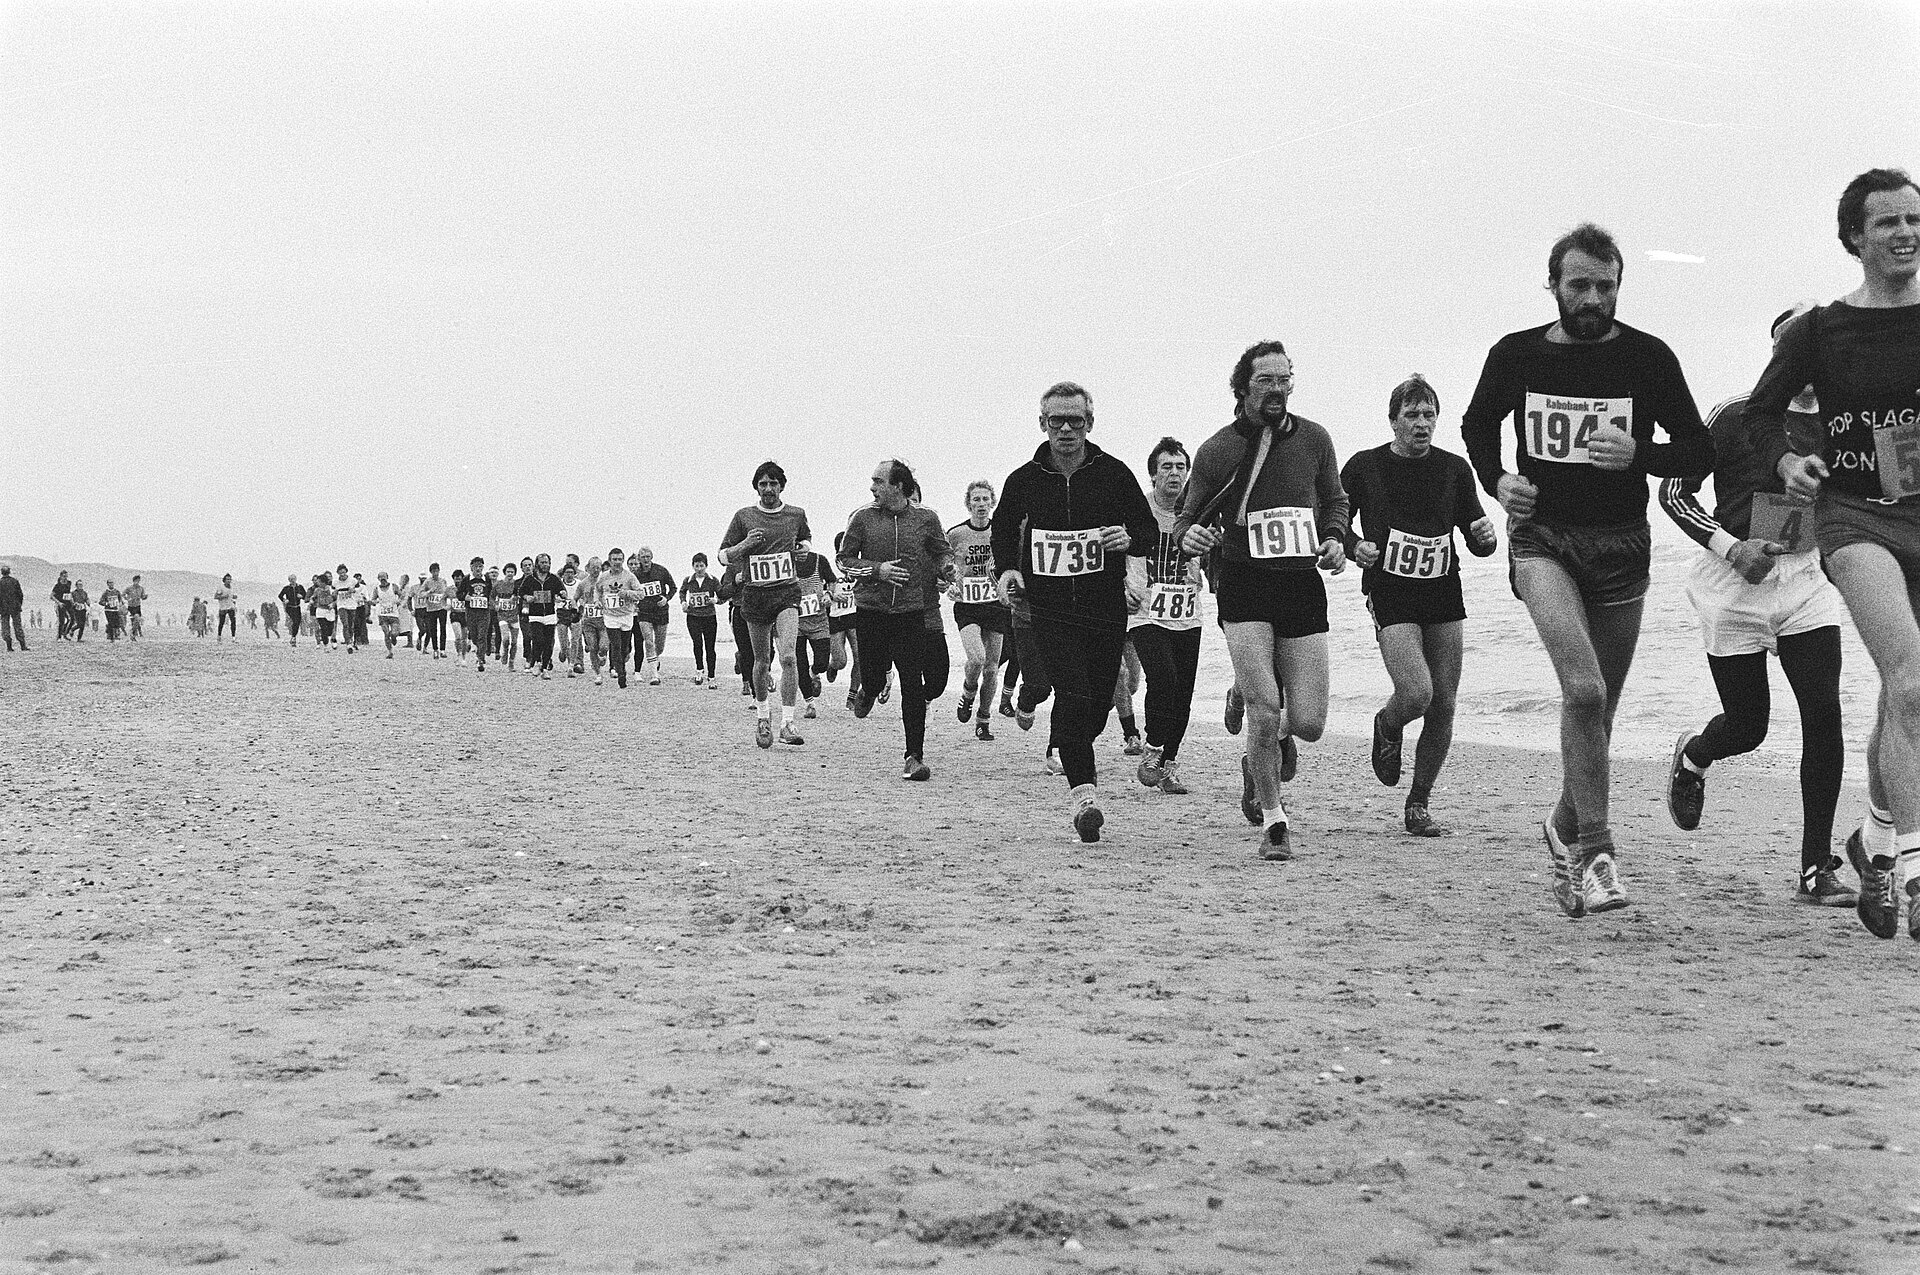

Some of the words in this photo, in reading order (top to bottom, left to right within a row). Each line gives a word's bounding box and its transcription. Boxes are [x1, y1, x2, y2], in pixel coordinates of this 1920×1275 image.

[1546, 398, 1589, 411] Rabobank
[1861, 409, 1919, 429] SLAG
[1046, 533, 1076, 541] Rabobank
[1250, 520, 1317, 556] 1911
[1403, 535, 1432, 546] Rabobank
[1034, 540, 1102, 574] 1739
[1388, 541, 1449, 577] 1951
[751, 558, 792, 580] 1014
[1150, 592, 1196, 619] 485
